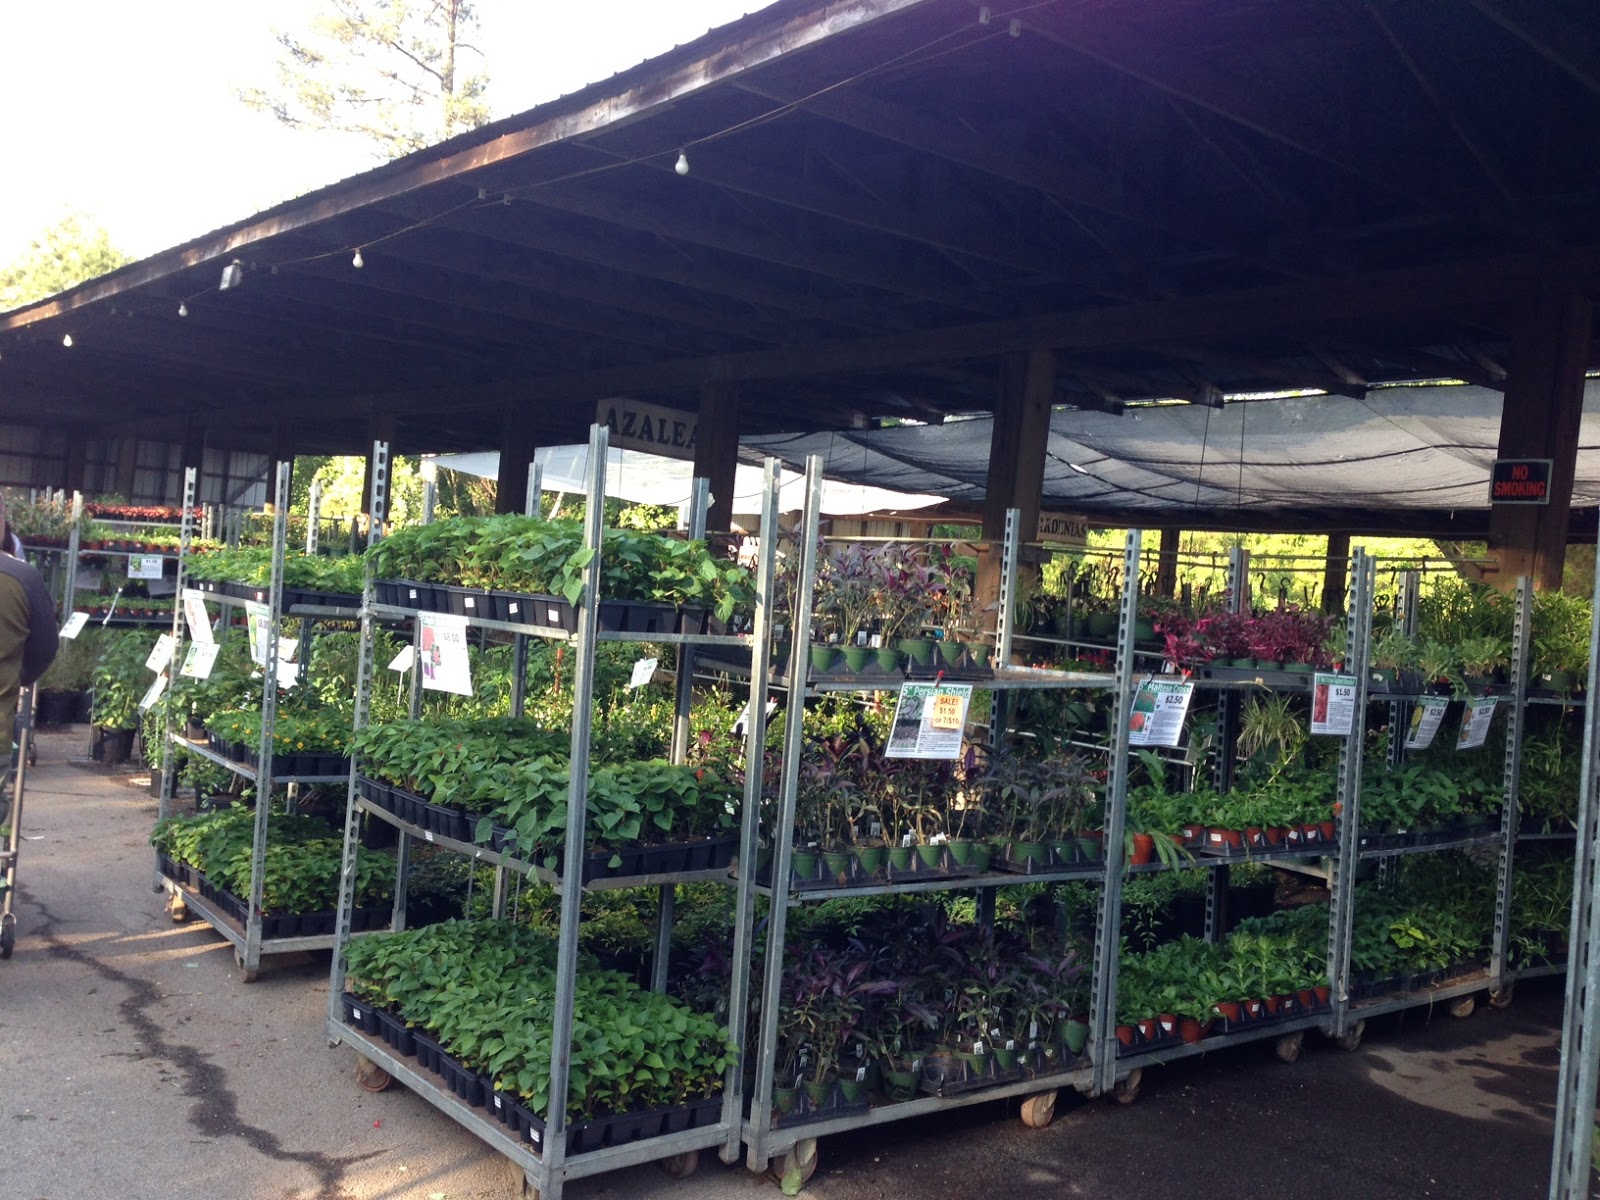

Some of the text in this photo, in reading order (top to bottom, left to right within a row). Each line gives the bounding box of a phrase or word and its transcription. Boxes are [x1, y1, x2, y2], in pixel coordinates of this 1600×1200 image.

[1512, 464, 1529, 480] NO
[1494, 481, 1546, 497] SMOKING
[913, 685, 944, 697] Persian
[945, 687, 970, 697] Shield
[1147, 682, 1173, 693] Maltese
[1173, 685, 1191, 695] Cross
[1335, 688, 1350, 696] $1.50
[940, 697, 959, 705] SALE!
[1165, 695, 1183, 705] $2.50
